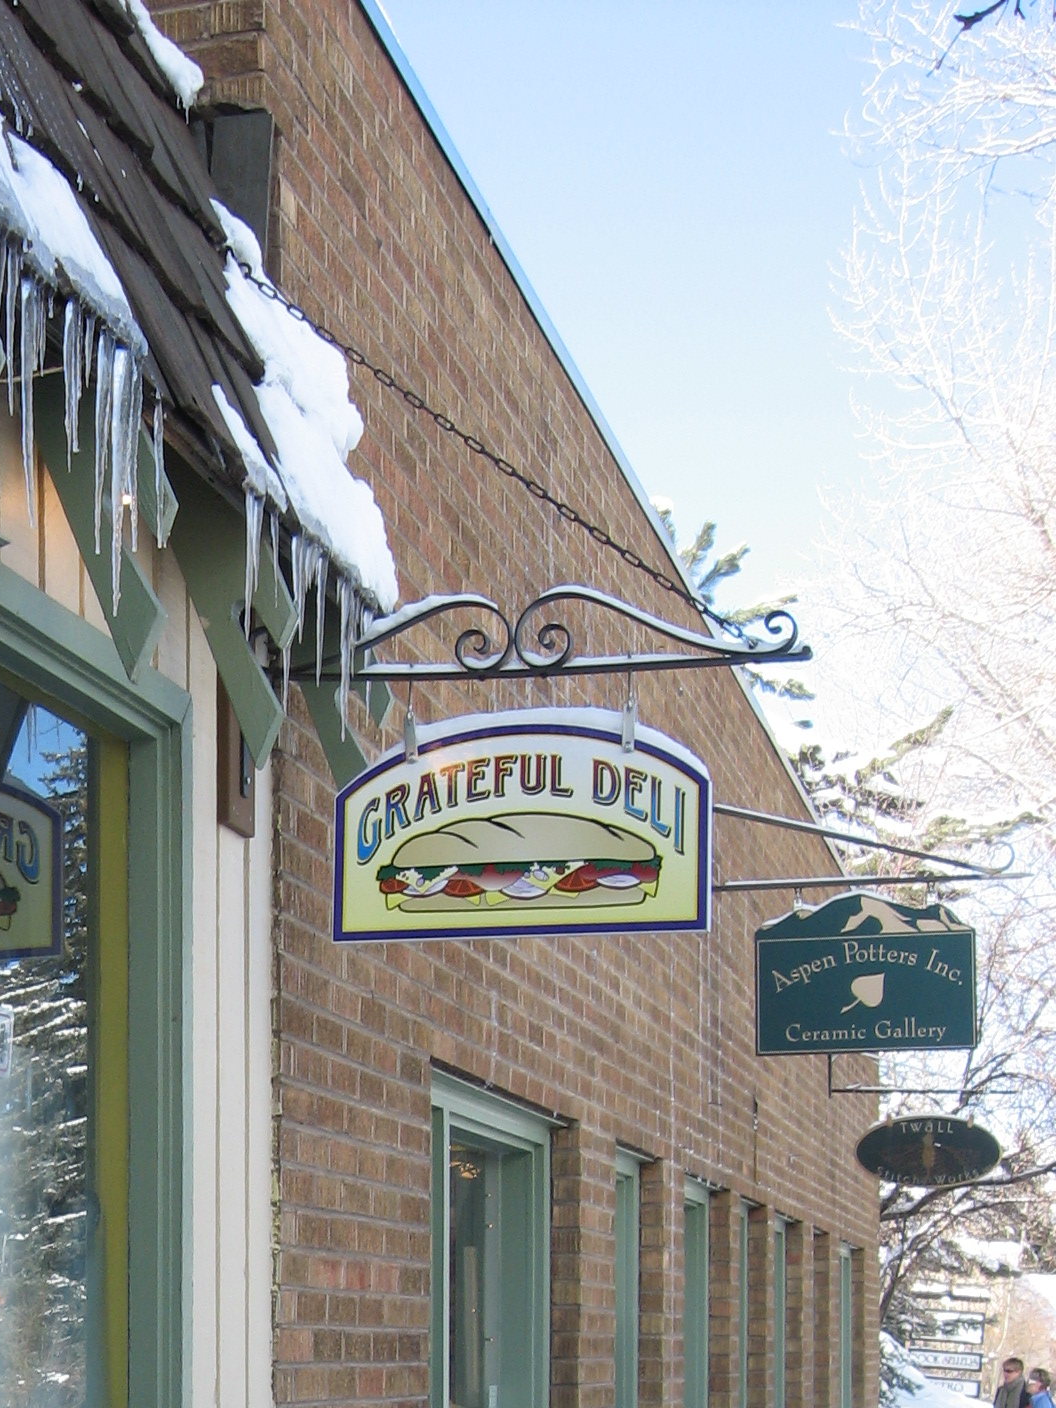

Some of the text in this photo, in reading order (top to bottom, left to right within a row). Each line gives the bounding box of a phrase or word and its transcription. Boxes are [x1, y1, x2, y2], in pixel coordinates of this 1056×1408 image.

[357, 754, 685, 865] GRATEFUL DELI
[771, 940, 964, 993] Aspen Potters Inc.
[785, 1016, 947, 1043] Ceramic Gallery
